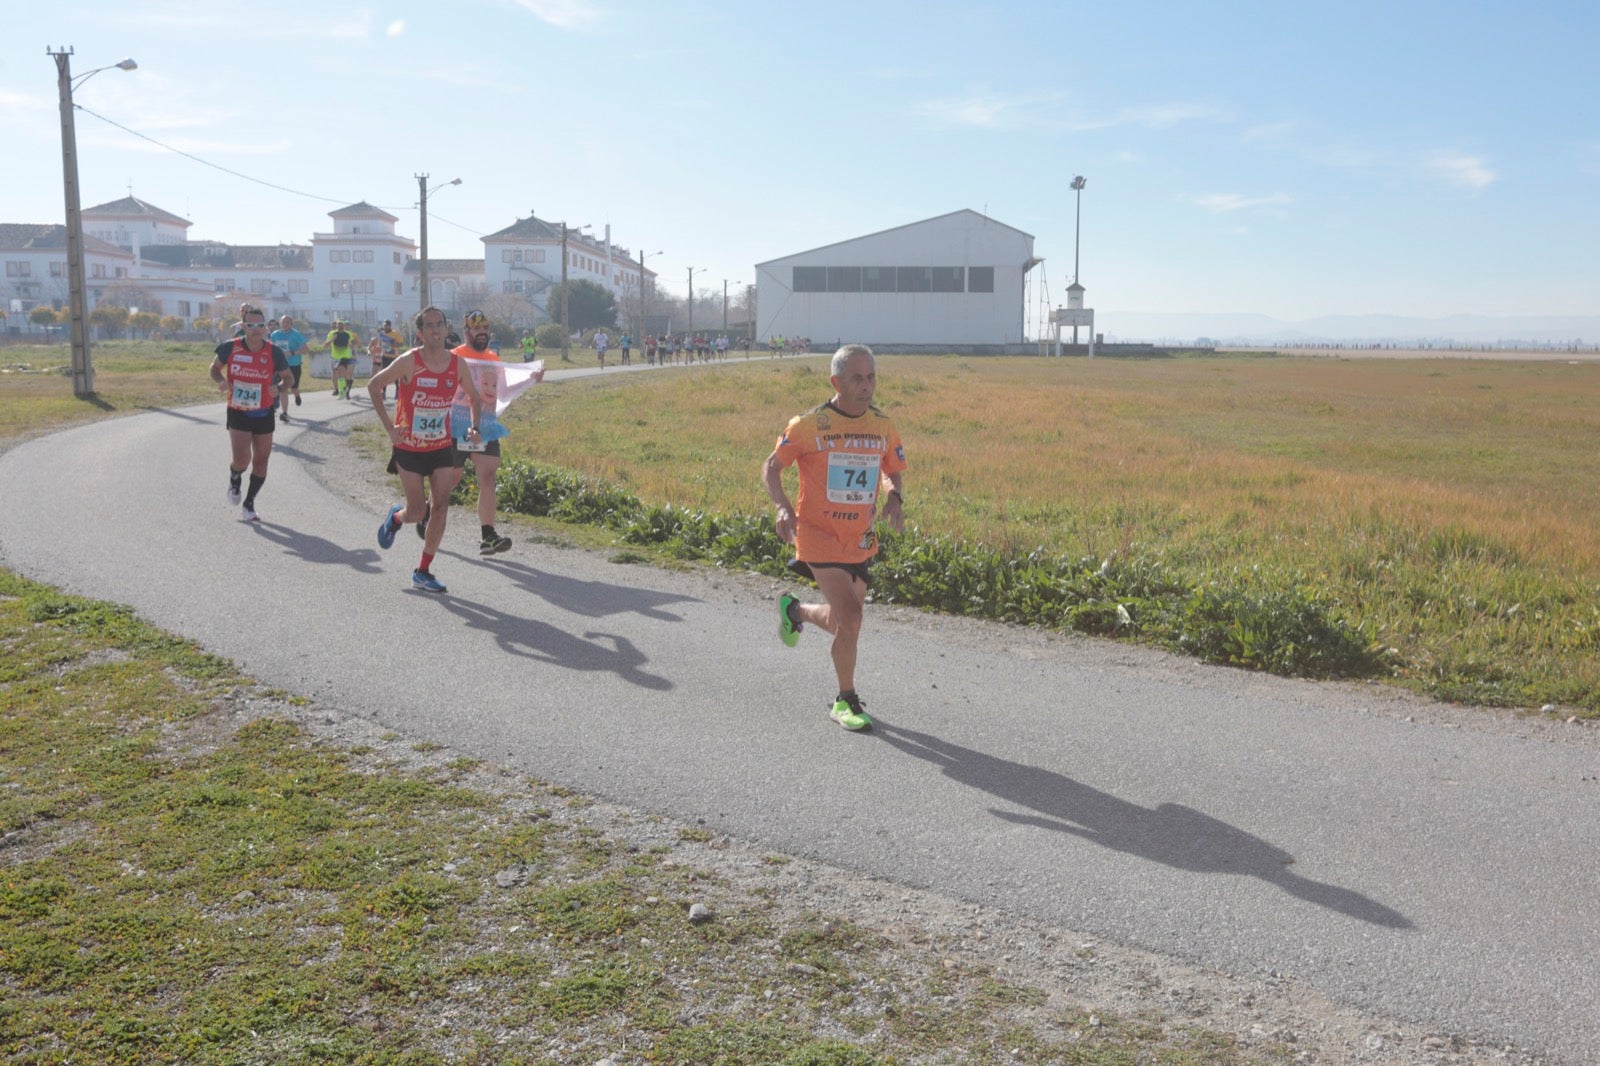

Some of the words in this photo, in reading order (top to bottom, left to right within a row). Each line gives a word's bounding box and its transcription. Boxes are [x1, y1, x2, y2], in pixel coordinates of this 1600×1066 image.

[237, 388, 257, 400] 734
[823, 433, 842, 441] Club
[844, 432, 882, 440] Deportivo
[844, 469, 867, 488] 74
